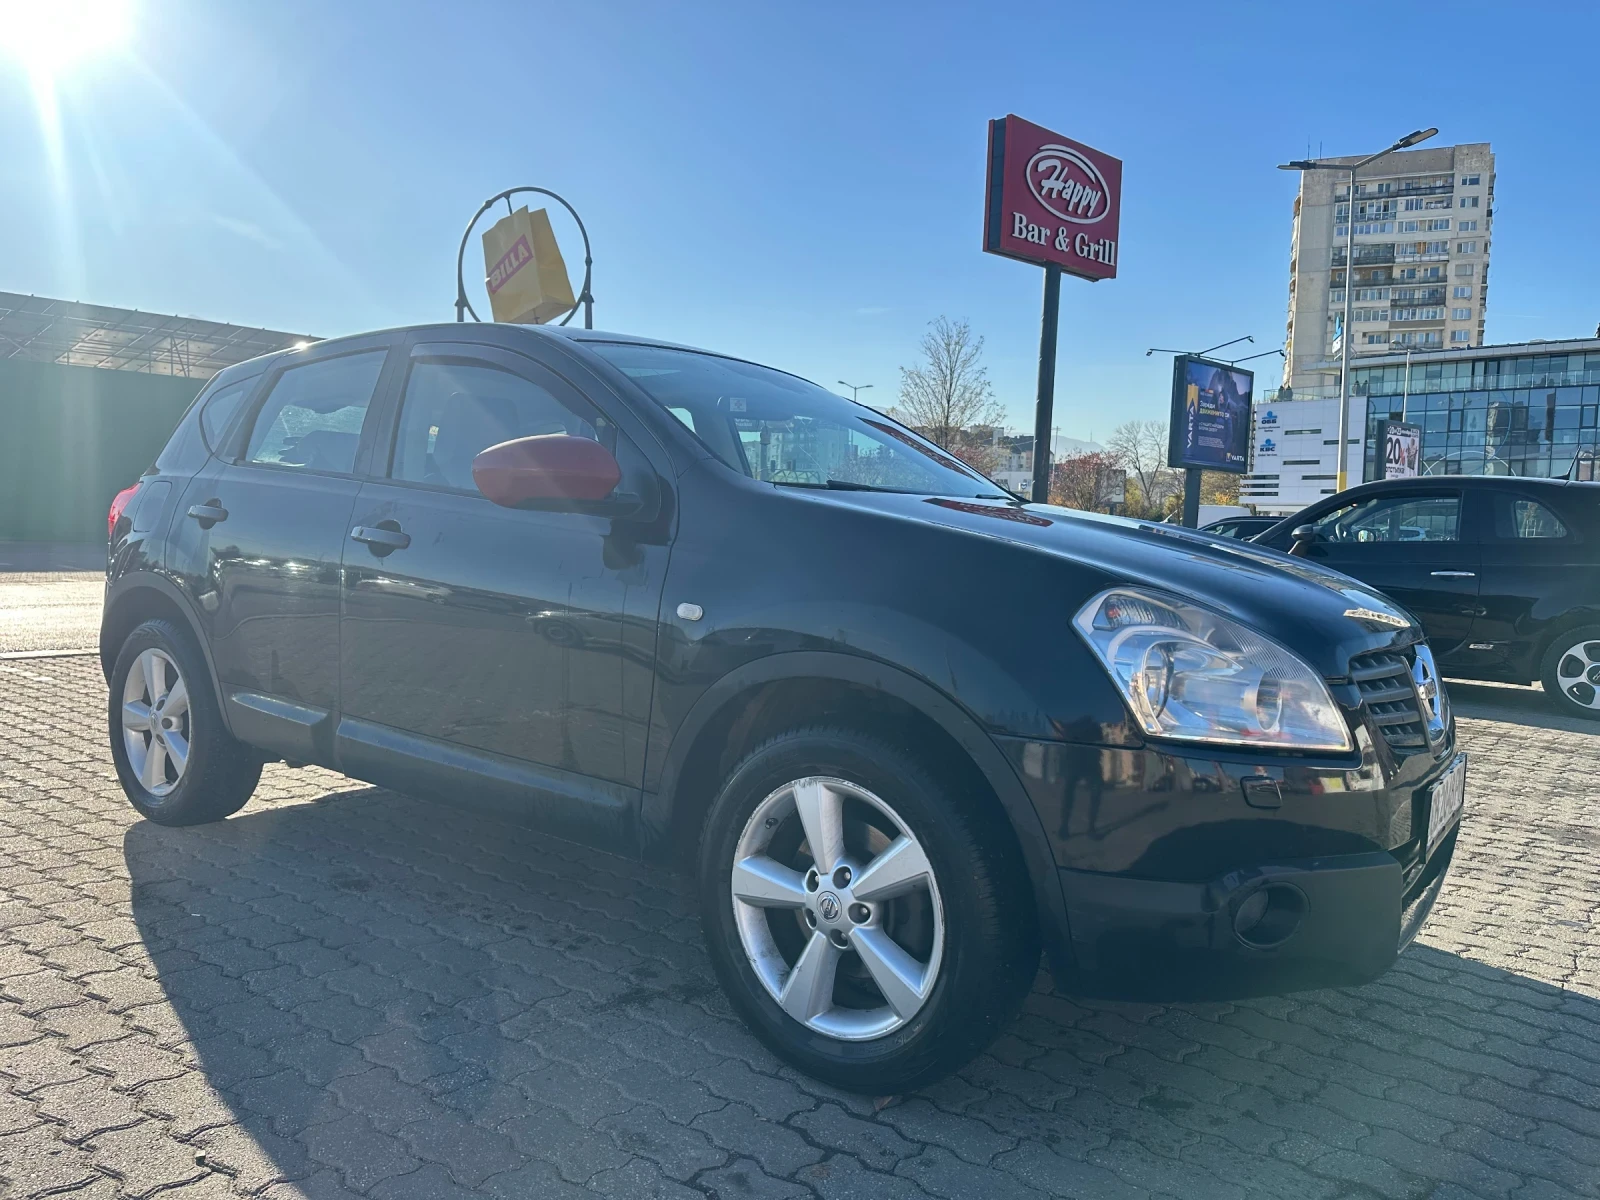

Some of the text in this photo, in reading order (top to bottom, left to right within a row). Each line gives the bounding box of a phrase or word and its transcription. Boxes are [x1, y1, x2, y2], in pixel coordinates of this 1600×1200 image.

[1037, 158, 1101, 217] Happy
[1012, 211, 1115, 266] Bar & Grill
[490, 243, 529, 289] BILLA
[1186, 405, 1194, 448] VARTA
[1386, 437, 1405, 466] 20%
